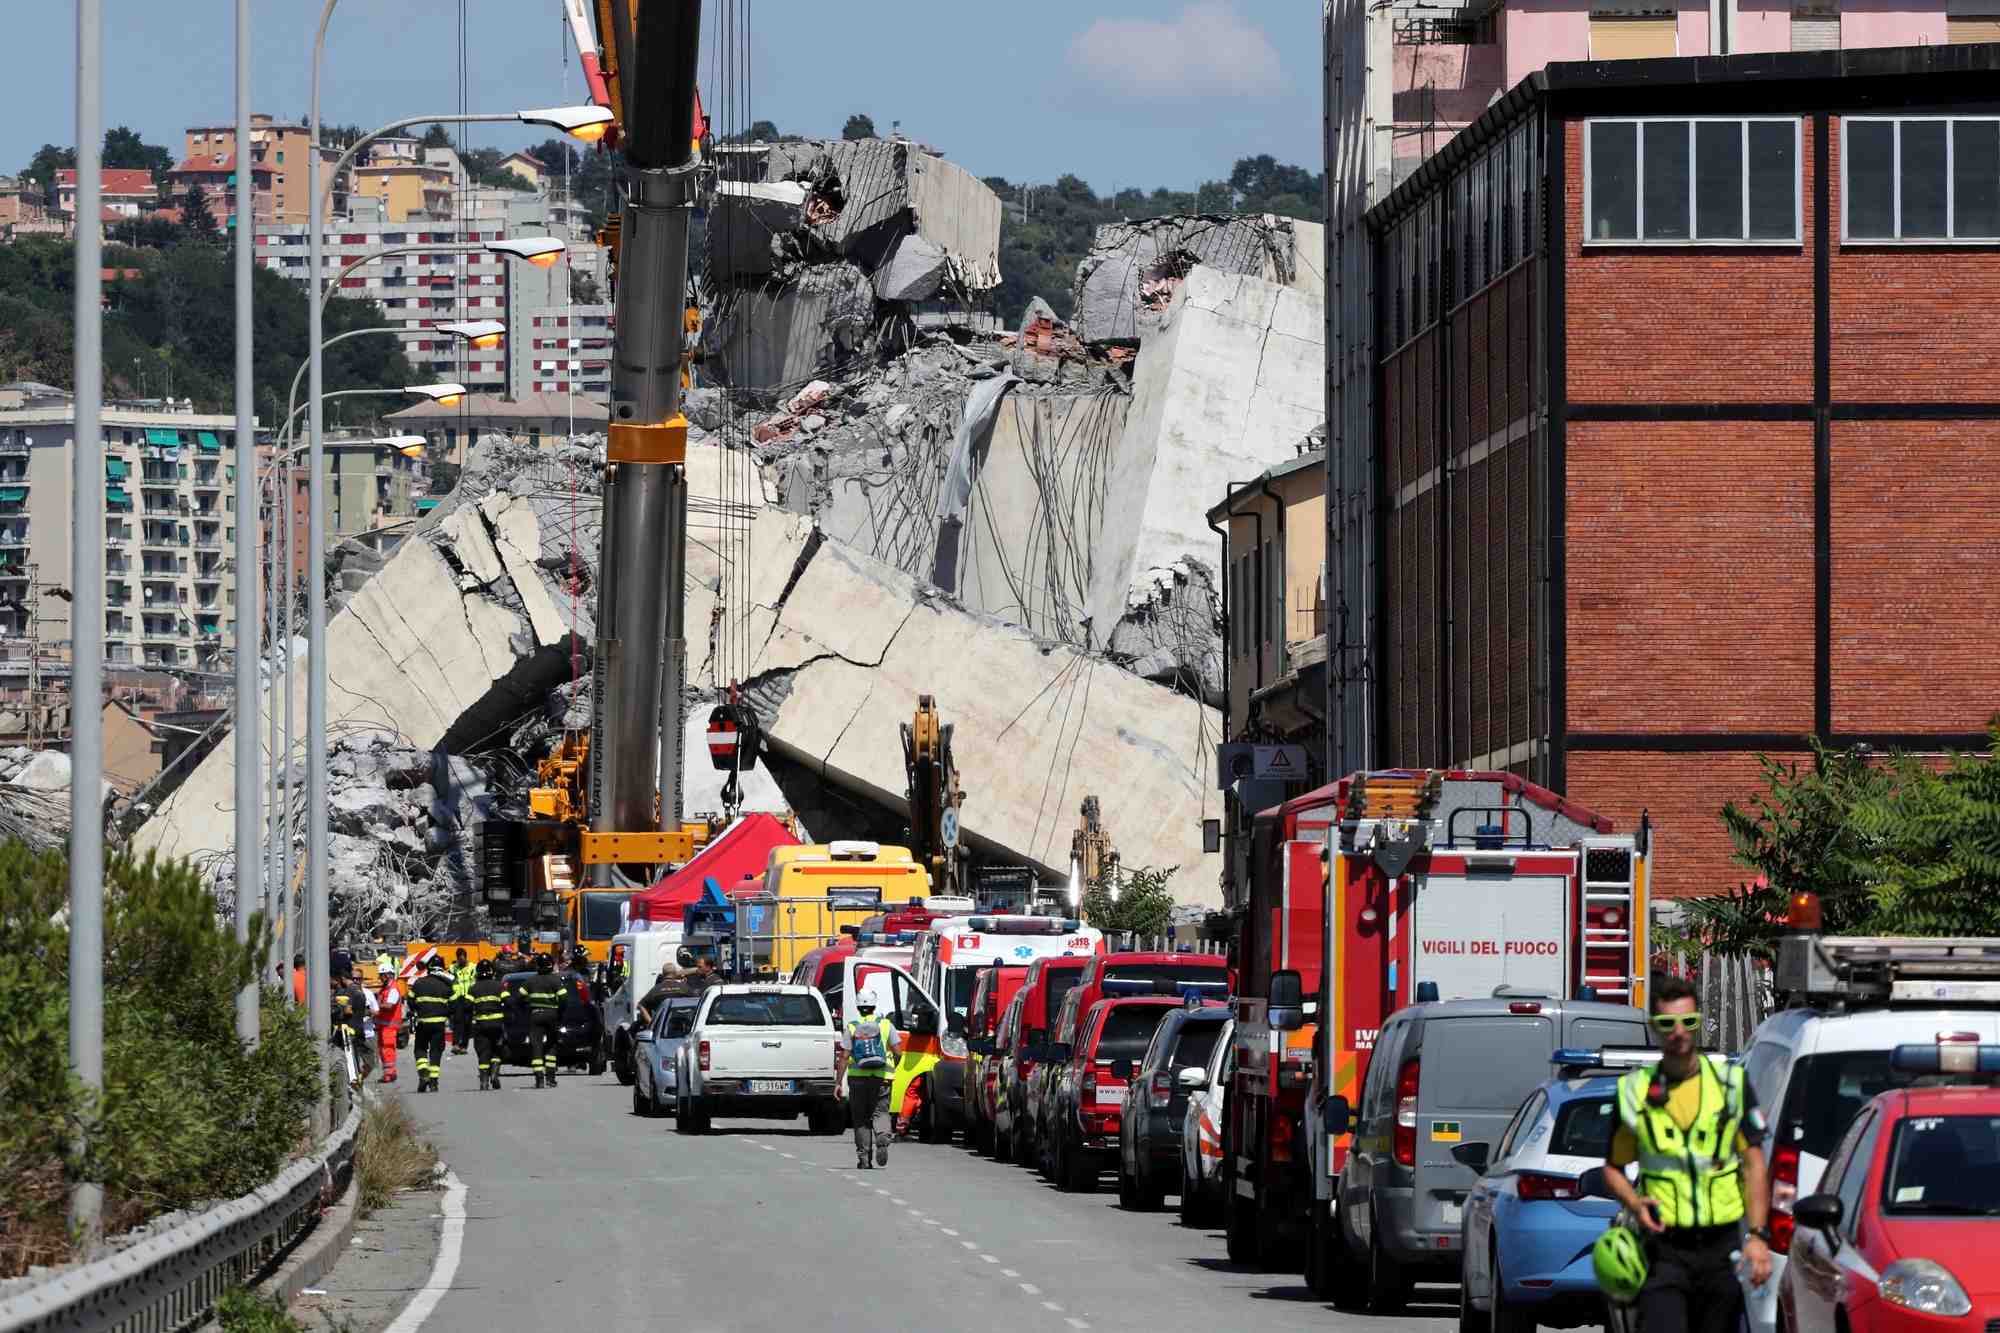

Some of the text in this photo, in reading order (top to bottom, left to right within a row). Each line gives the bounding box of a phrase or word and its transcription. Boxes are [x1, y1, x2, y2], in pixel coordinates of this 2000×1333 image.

[592, 711, 604, 774] MOMENT
[592, 777, 603, 817] LOAD
[1422, 940, 1558, 956] VIGILI DEL FUOCO
